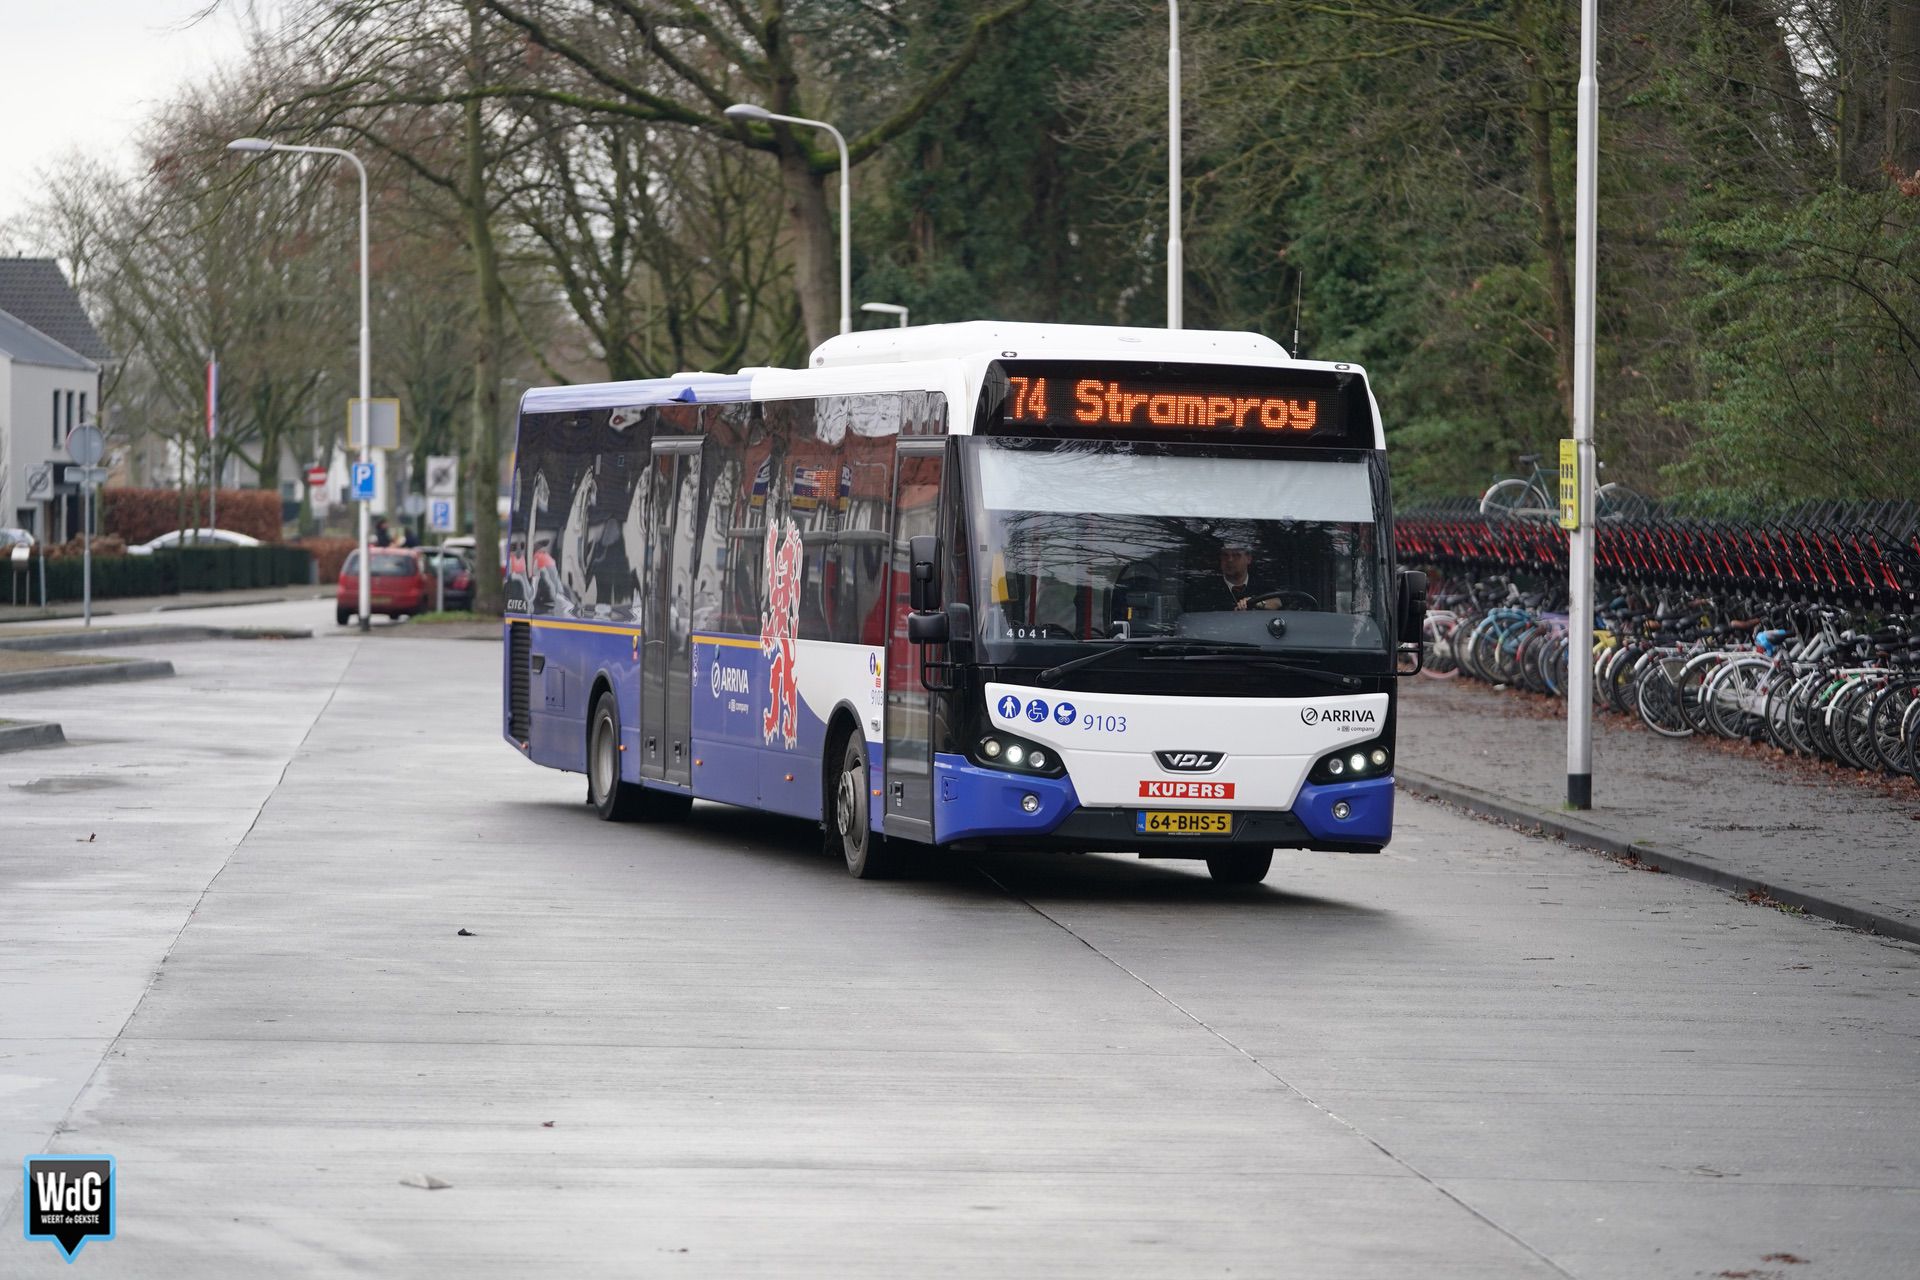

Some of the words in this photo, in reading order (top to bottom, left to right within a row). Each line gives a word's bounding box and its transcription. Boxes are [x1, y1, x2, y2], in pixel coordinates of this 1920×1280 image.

[1010, 376, 1047, 420] 74
[1075, 378, 1317, 430] Stramproy
[357, 465, 371, 485] P
[507, 599, 527, 610] CITEA
[1006, 628, 1048, 639] 4041
[720, 666, 749, 694] ARRIVA
[1321, 709, 1375, 722] ARRIVA
[1083, 714, 1127, 733] 9103
[1164, 753, 1213, 767] VDL
[1148, 783, 1226, 798] KUPERS
[1150, 815, 1226, 831] 64-BHS-5
